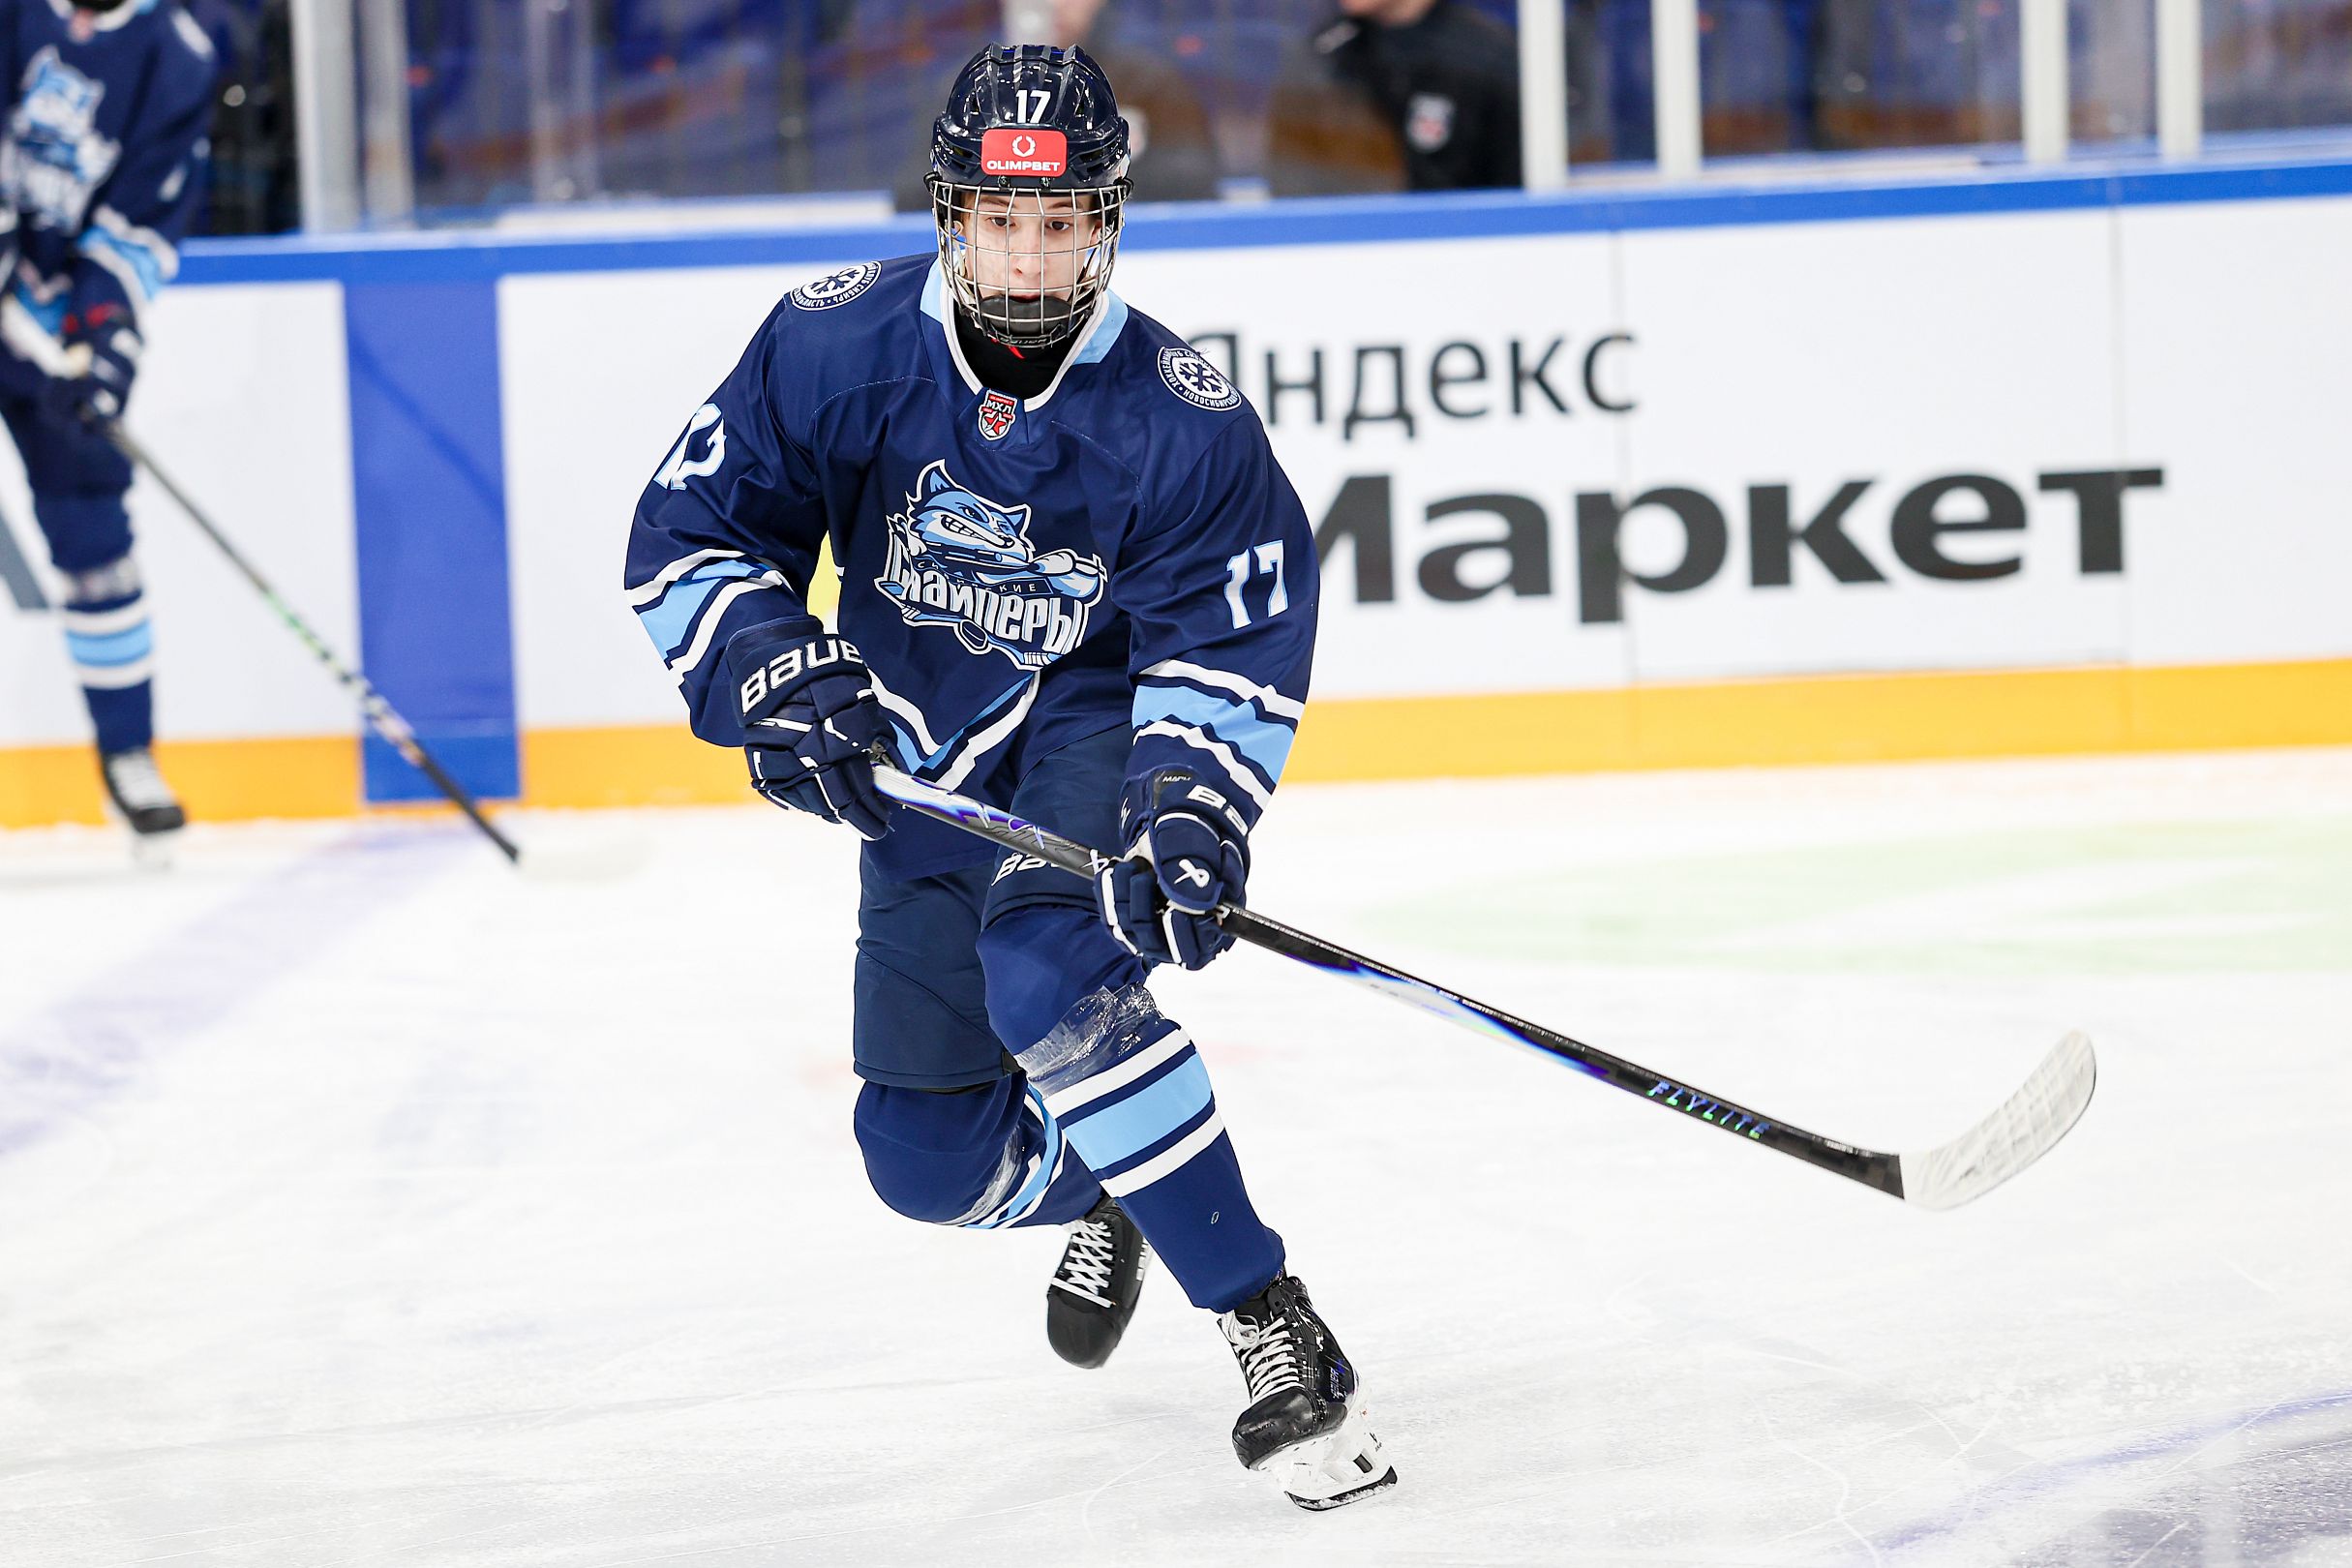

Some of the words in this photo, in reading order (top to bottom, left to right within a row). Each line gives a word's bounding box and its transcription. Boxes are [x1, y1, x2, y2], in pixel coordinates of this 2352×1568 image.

[1016, 89, 1051, 124] 17
[986, 160, 1061, 172] OLIMPBET
[833, 283, 865, 304] СИБИРЬ
[986, 399, 1012, 415] МХЛ
[1222, 539, 1289, 630] 17
[740, 638, 864, 716] BAUE
[1647, 1080, 1771, 1140] FLYLITE
